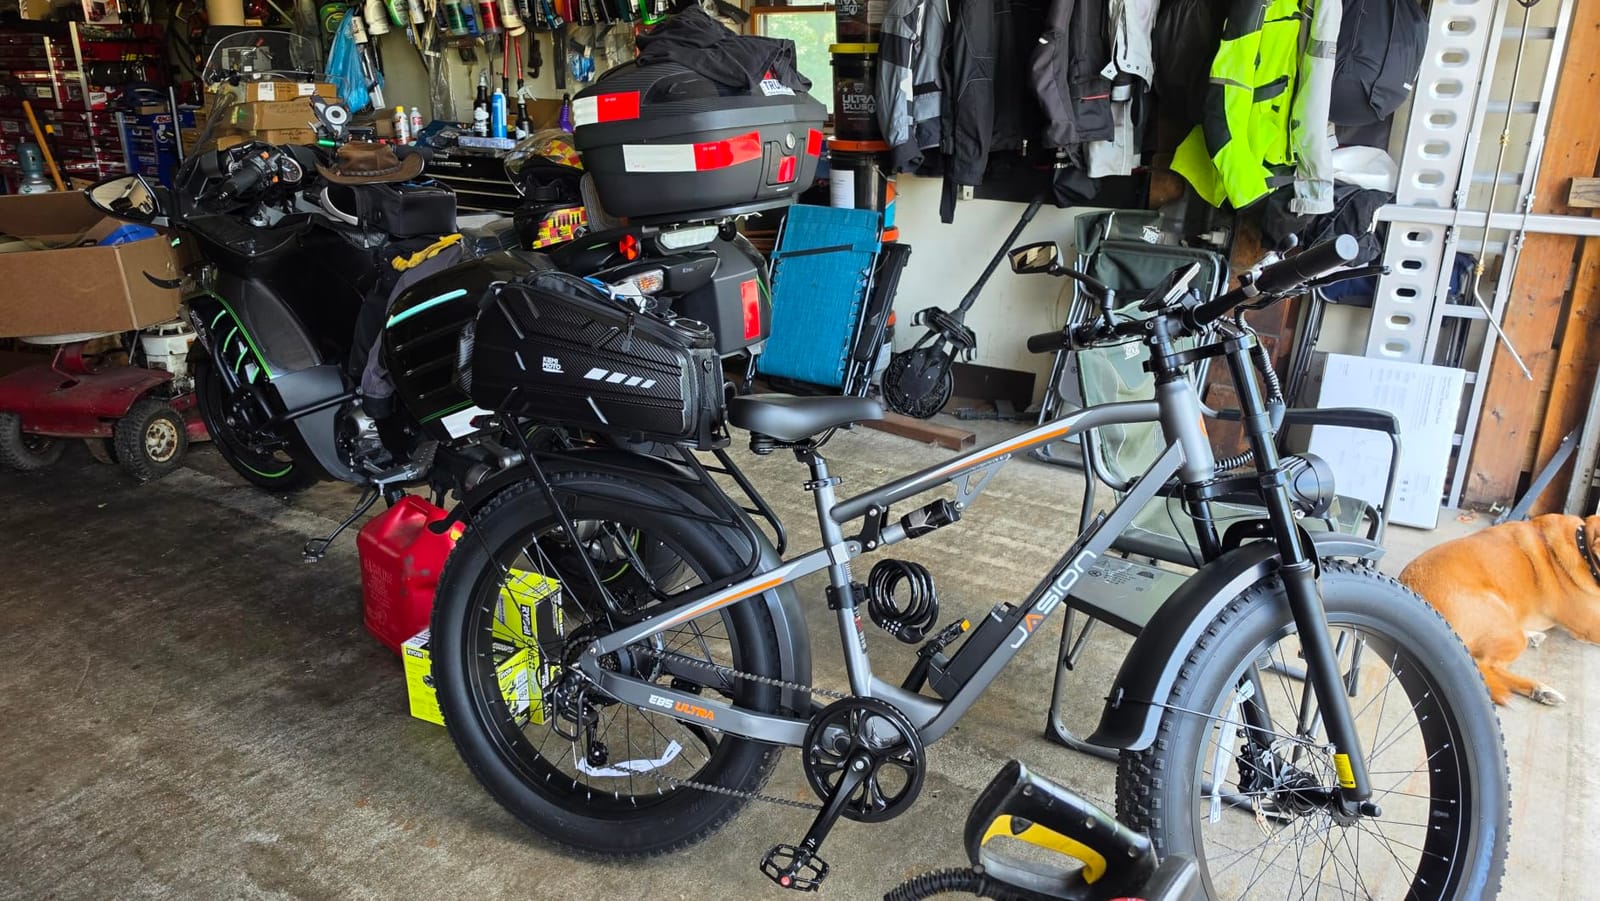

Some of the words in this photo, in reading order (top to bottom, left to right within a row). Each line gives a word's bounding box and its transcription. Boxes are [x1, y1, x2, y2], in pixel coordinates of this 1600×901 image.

[842, 94, 876, 104] ULTRA
[843, 103, 868, 111] PLUS
[1010, 549, 1097, 649] JASION
[674, 700, 715, 721] ULTRA
